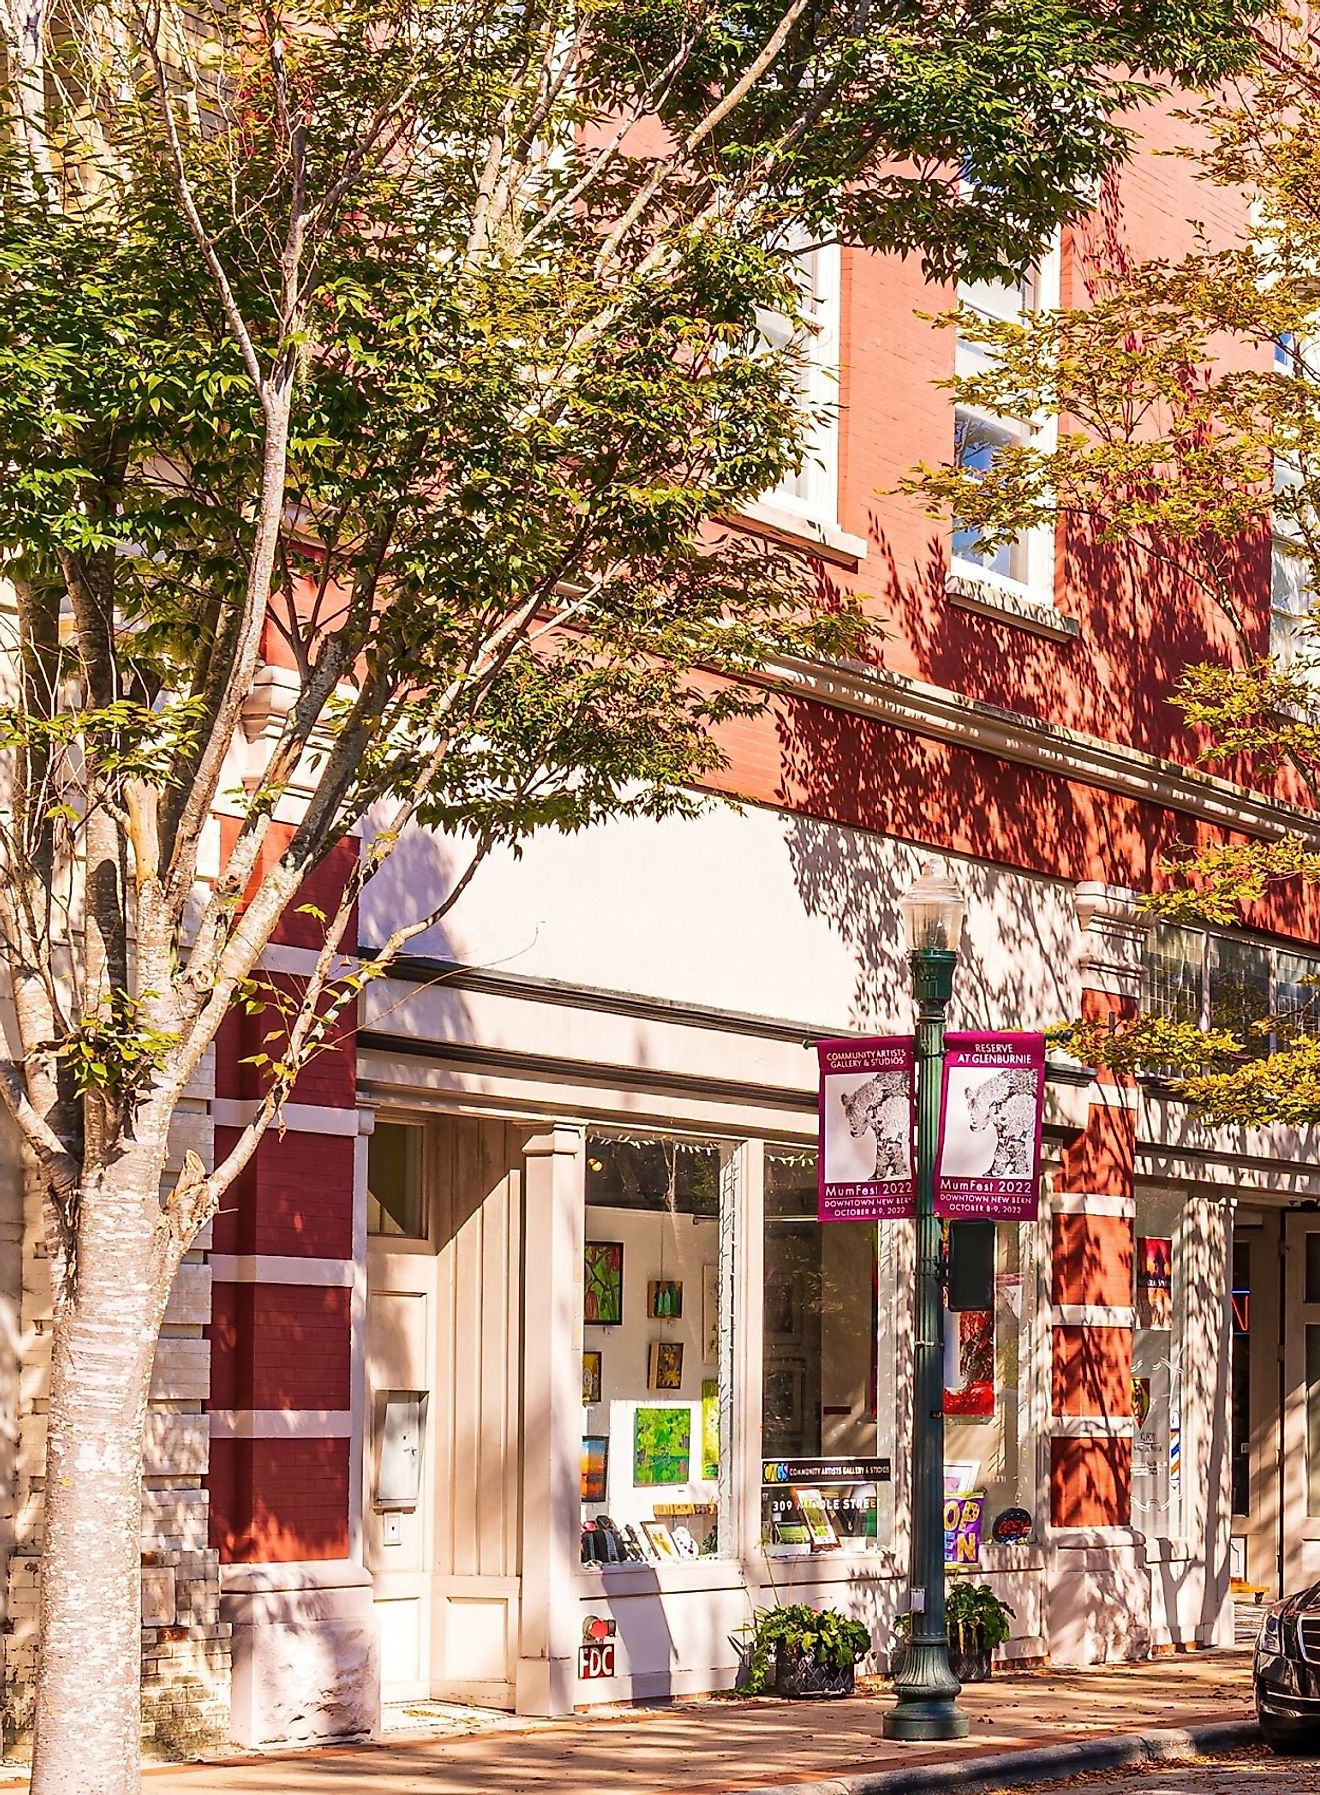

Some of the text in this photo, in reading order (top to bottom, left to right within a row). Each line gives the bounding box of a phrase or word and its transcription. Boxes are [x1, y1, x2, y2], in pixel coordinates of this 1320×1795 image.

[975, 1044, 1013, 1053] RESERVE
[826, 1048, 906, 1061] COMMUNITY ARTISTS
[957, 1053, 1032, 1064] AT GLENBURNIE
[830, 1057, 904, 1068] GALLERY & STUDIOS
[825, 1182, 913, 1197] MumFest 2022
[940, 1179, 1032, 1193] MumFest 2022
[825, 1199, 875, 1208] DOWNTOWN
[940, 1194, 1032, 1204] DOWNTOWN NEW BERN
[834, 1207, 870, 1217] OCTOBER
[886, 1207, 905, 1215] 2022
[949, 1203, 984, 1213] OCTOBER
[1002, 1205, 1022, 1214] 2022
[789, 1467, 821, 1477] COMMUNITY
[821, 1466, 842, 1476] ARTISTS
[842, 1465, 865, 1475] GALLERY
[772, 1500, 793, 1511] 309
[579, 1646, 613, 1677] FDC
